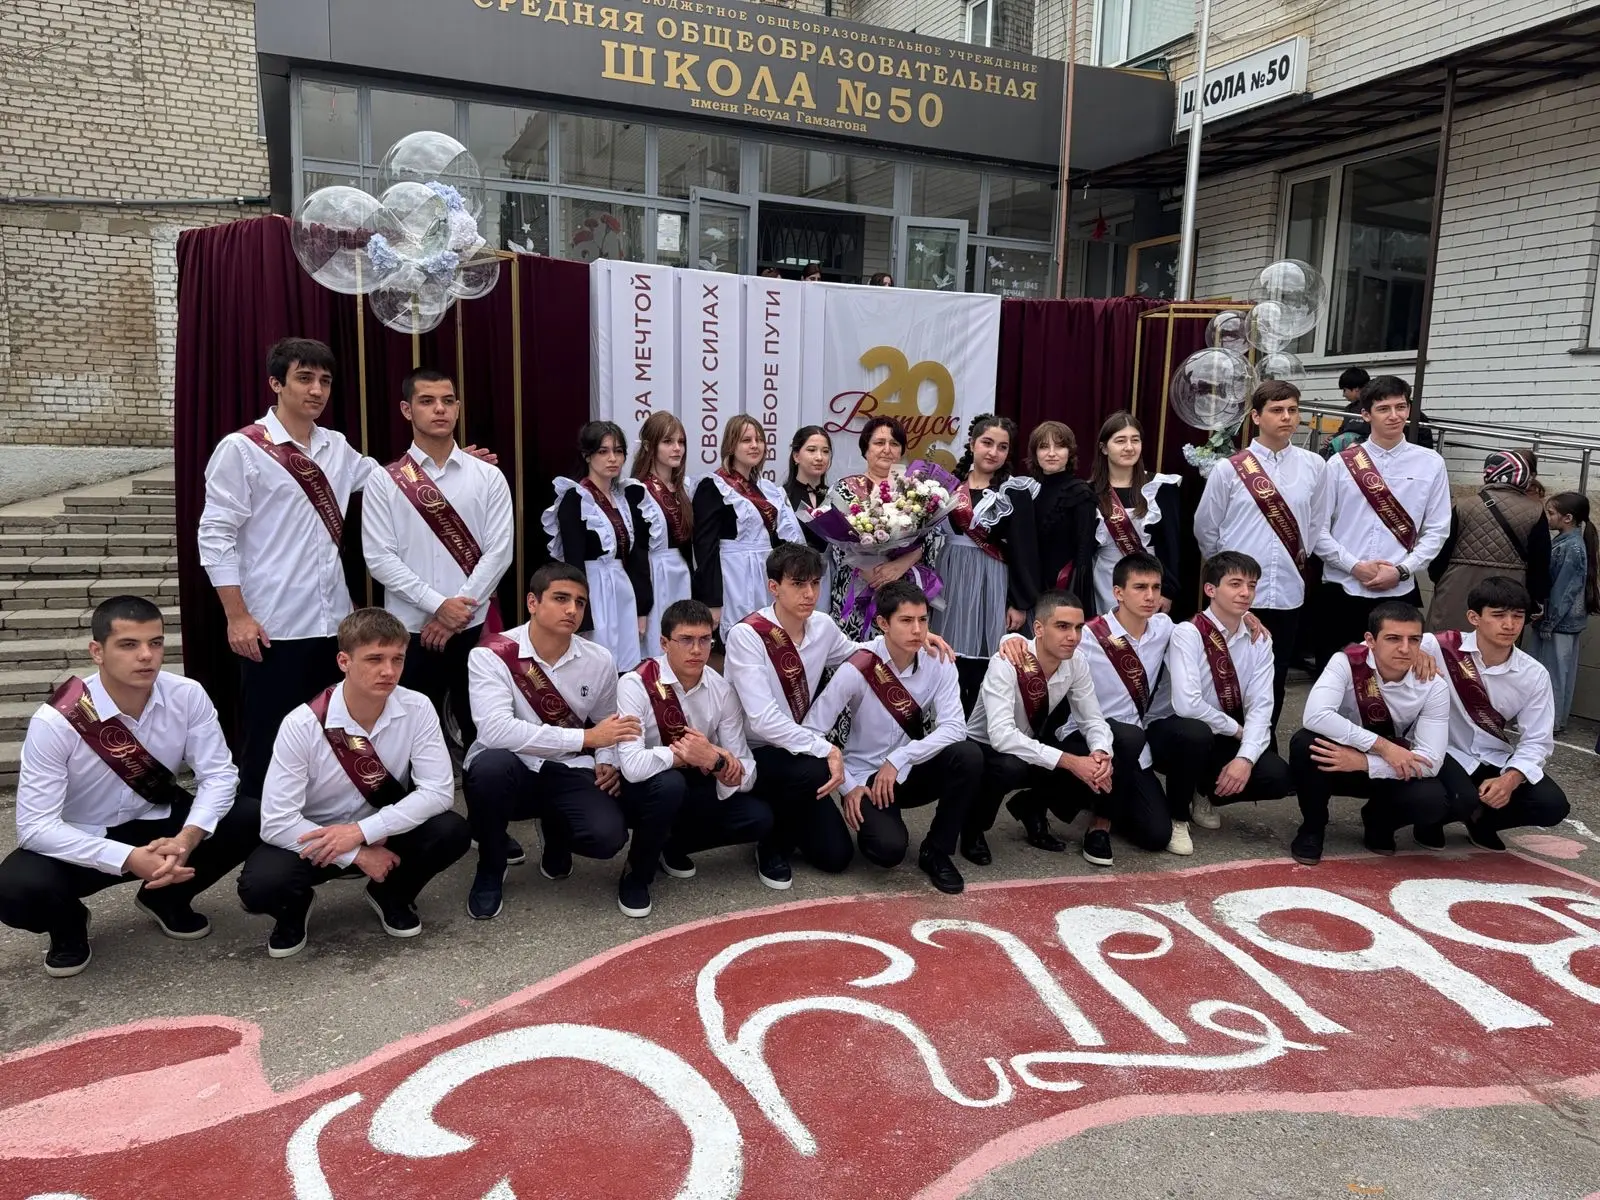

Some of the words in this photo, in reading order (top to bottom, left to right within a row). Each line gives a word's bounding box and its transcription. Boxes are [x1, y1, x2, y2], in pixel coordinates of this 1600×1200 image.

[656, 17, 1038, 101] ОБЩЕОБРАЗОВАТЕЛЬНАЯ
[756, 14, 941, 56] ОБЩЕОБРАЗОВАТЕЛЬНОЕ
[949, 48, 1038, 73] УЧРЕЖДЕНИЕ
[1250, 54, 1290, 91] №50
[601, 39, 816, 110] ШКОЛА
[836, 78, 944, 128] №50
[690, 98, 739, 114] имени
[743, 103, 791, 122] Расула
[796, 111, 867, 133] Гамзатова
[630, 273, 652, 381] МЕЧТОЙ
[702, 284, 719, 371] СИЛАХ
[764, 290, 781, 354] ПУТИ
[763, 363, 779, 462] ВЫБОРЕ
[823, 391, 961, 450] Впуск
[858, 345, 955, 418] 20
[701, 380, 719, 464] СВОИХ
